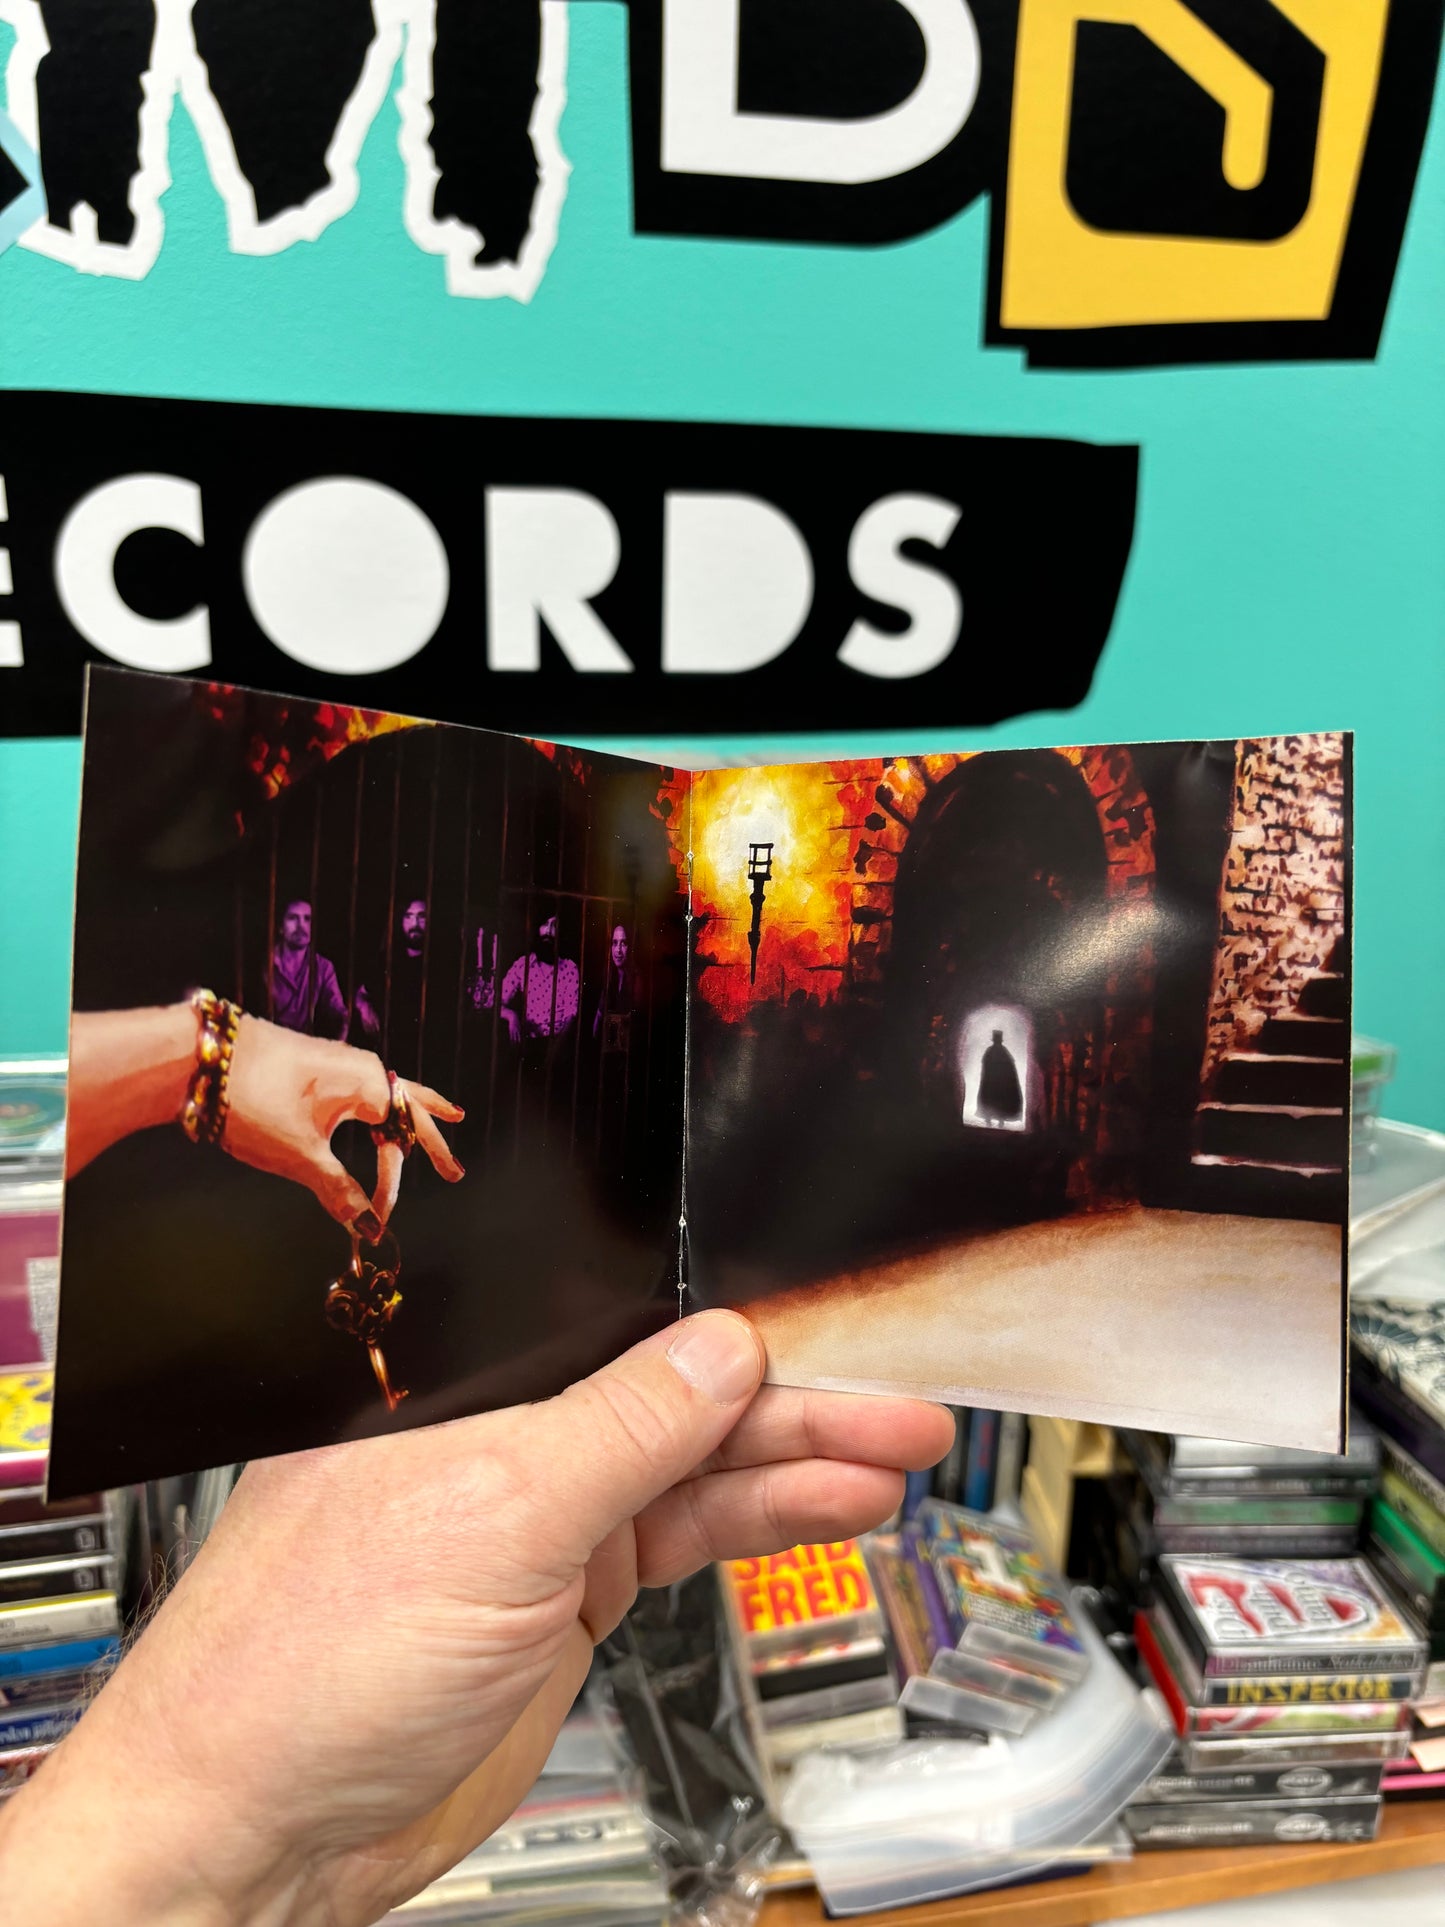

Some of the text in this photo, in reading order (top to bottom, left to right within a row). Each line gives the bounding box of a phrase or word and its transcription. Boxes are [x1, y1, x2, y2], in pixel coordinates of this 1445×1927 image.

[0, 472, 963, 679] CORDS
[739, 1566, 868, 1632] FRED
[1226, 1676, 1393, 1704] INSPECTOR
